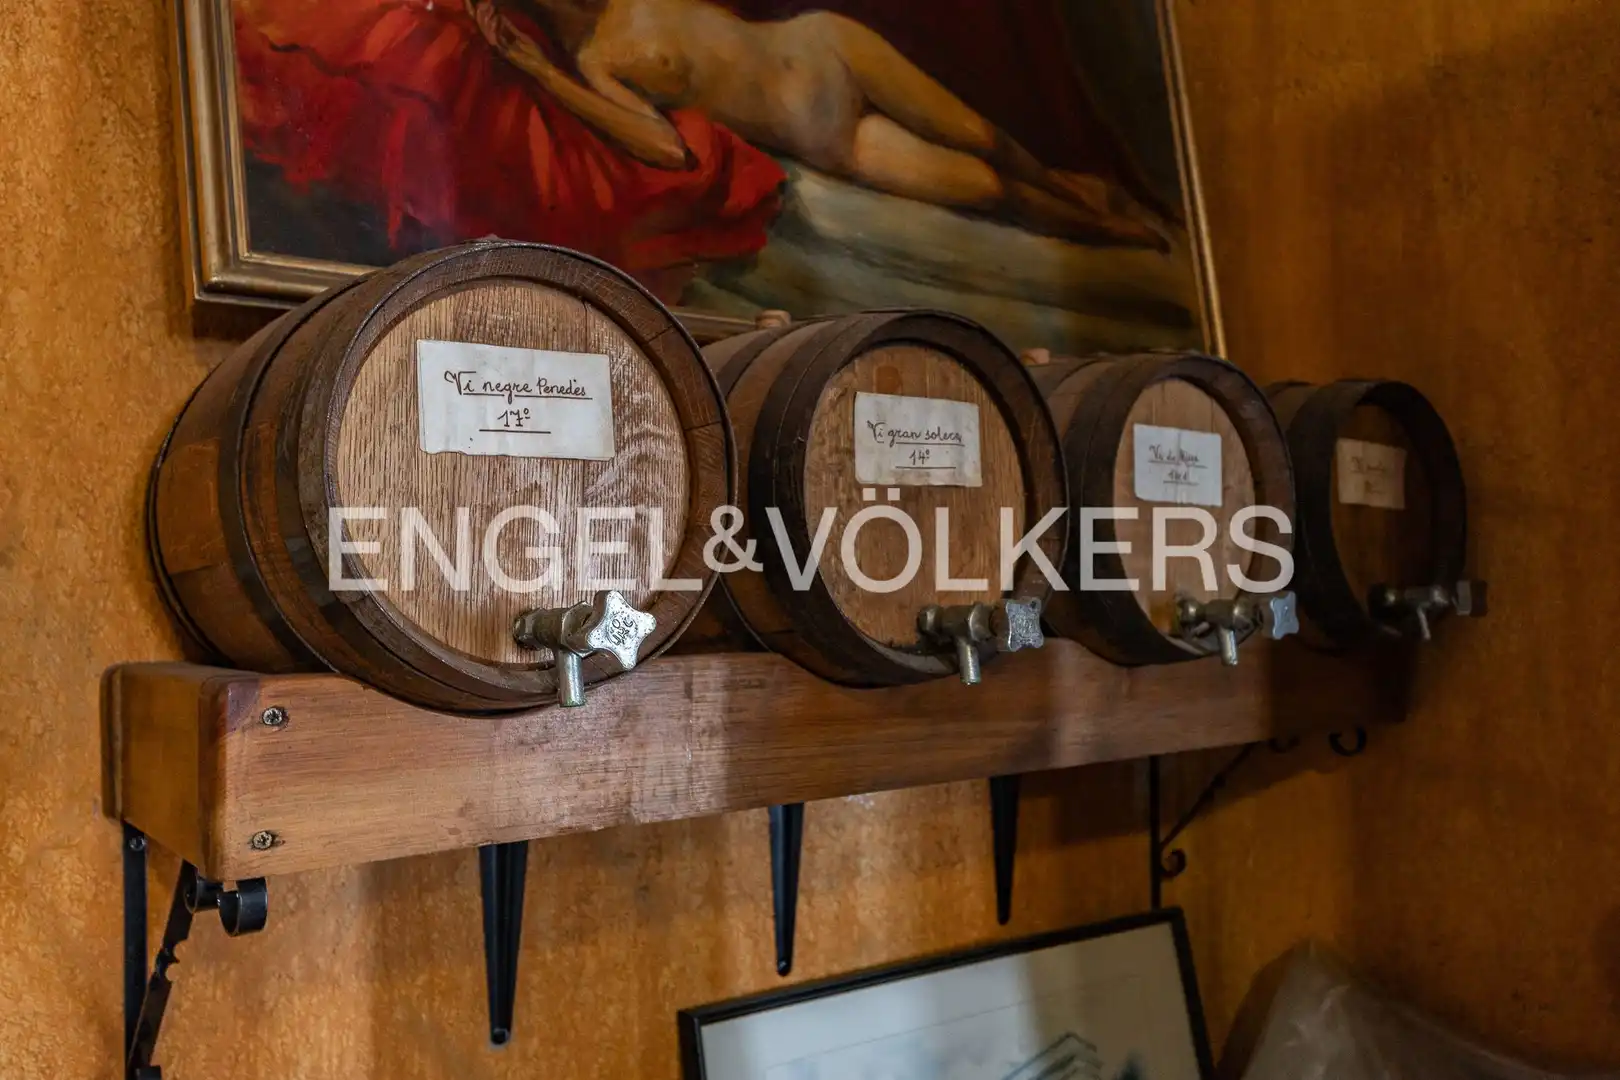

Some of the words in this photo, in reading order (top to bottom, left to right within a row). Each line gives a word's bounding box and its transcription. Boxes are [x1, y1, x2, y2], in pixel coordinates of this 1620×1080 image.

[444, 370, 477, 395] Vi
[482, 379, 533, 405] negre
[887, 428, 921, 448] gran
